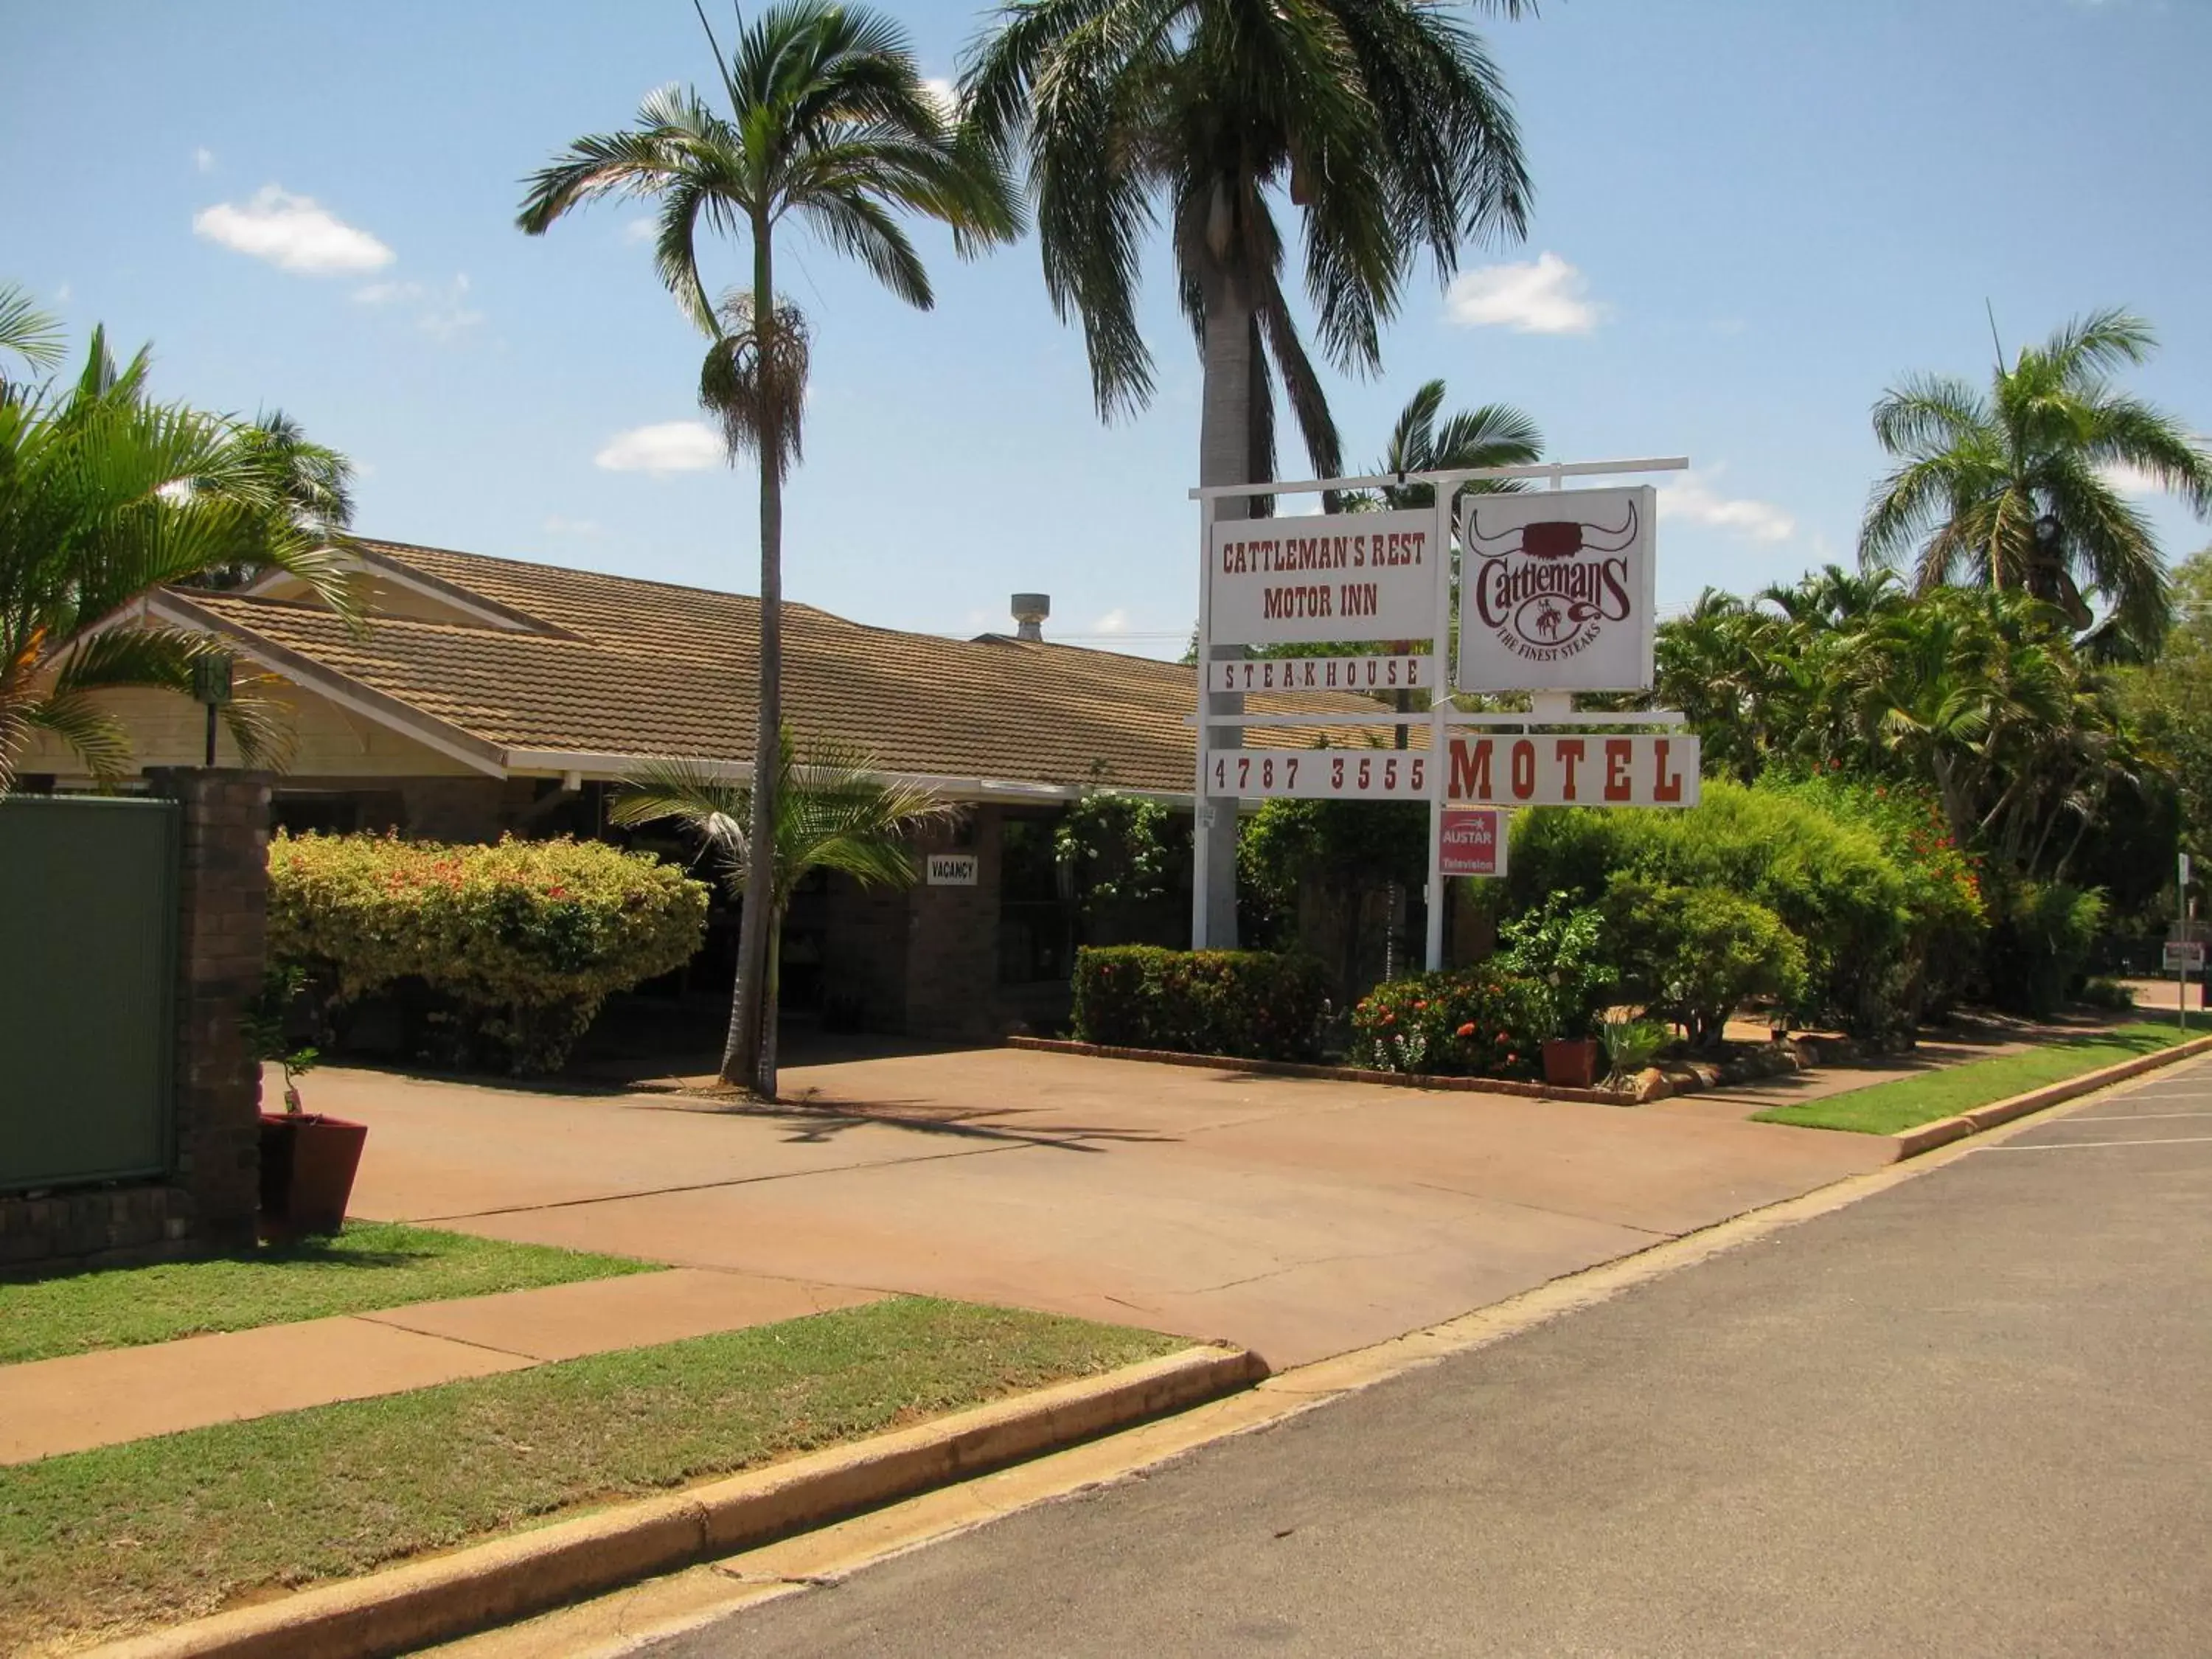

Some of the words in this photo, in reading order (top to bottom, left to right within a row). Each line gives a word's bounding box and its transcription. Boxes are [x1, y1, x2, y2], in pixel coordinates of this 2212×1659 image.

[1222, 536, 1365, 573] CATTLEMAN'S
[1371, 532, 1426, 567] REST
[1263, 585, 1332, 619] MOTOR
[1340, 583, 1377, 616] INN
[1497, 627, 1520, 652] THE
[1517, 644, 1559, 661] FINEST
[1560, 622, 1601, 660] STEAKS
[1225, 659, 1418, 689] STEAKHOUSE
[1215, 758, 1298, 789] 4787
[1331, 758, 1425, 791] 3555
[1447, 740, 1682, 802] MOTEL
[1443, 829, 1492, 844] AUSTAR
[931, 860, 973, 880] VACANCY
[1443, 857, 1494, 871] Television
